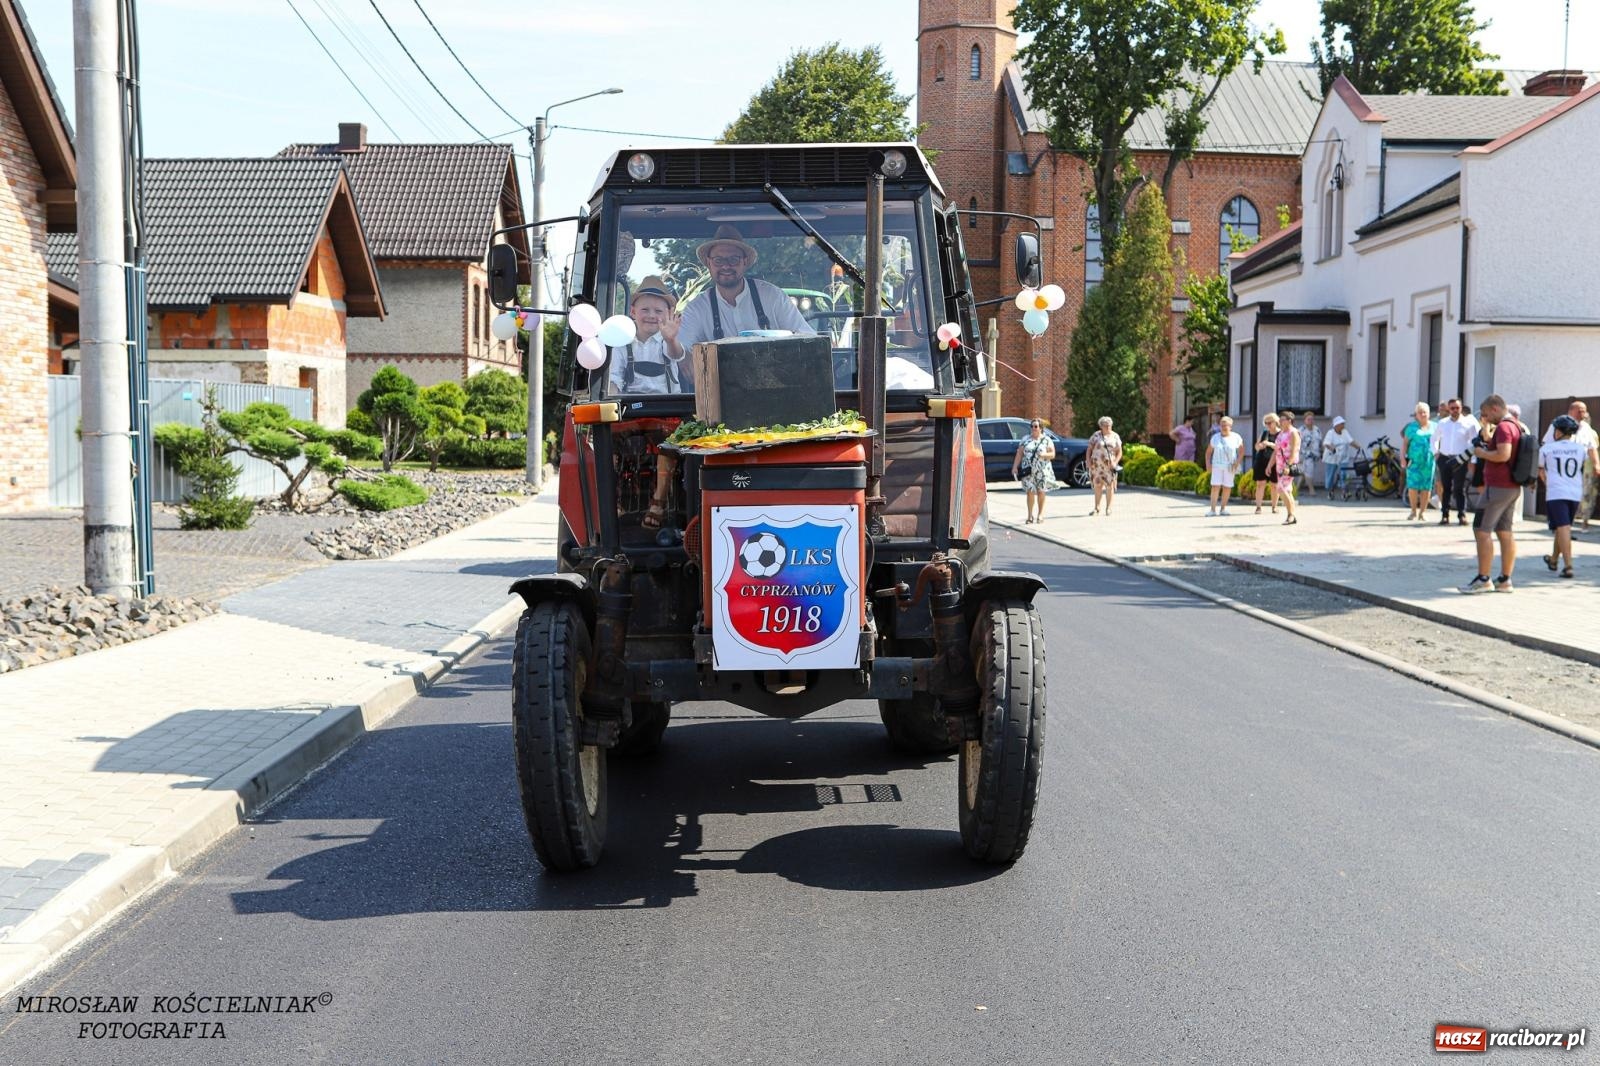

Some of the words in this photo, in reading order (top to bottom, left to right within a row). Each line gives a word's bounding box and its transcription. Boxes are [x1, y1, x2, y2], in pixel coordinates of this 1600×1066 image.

[1553, 456, 1578, 478] 10
[789, 548, 833, 566] LKS
[740, 582, 836, 597] CYPRZANÓW
[757, 605, 822, 633] 1918
